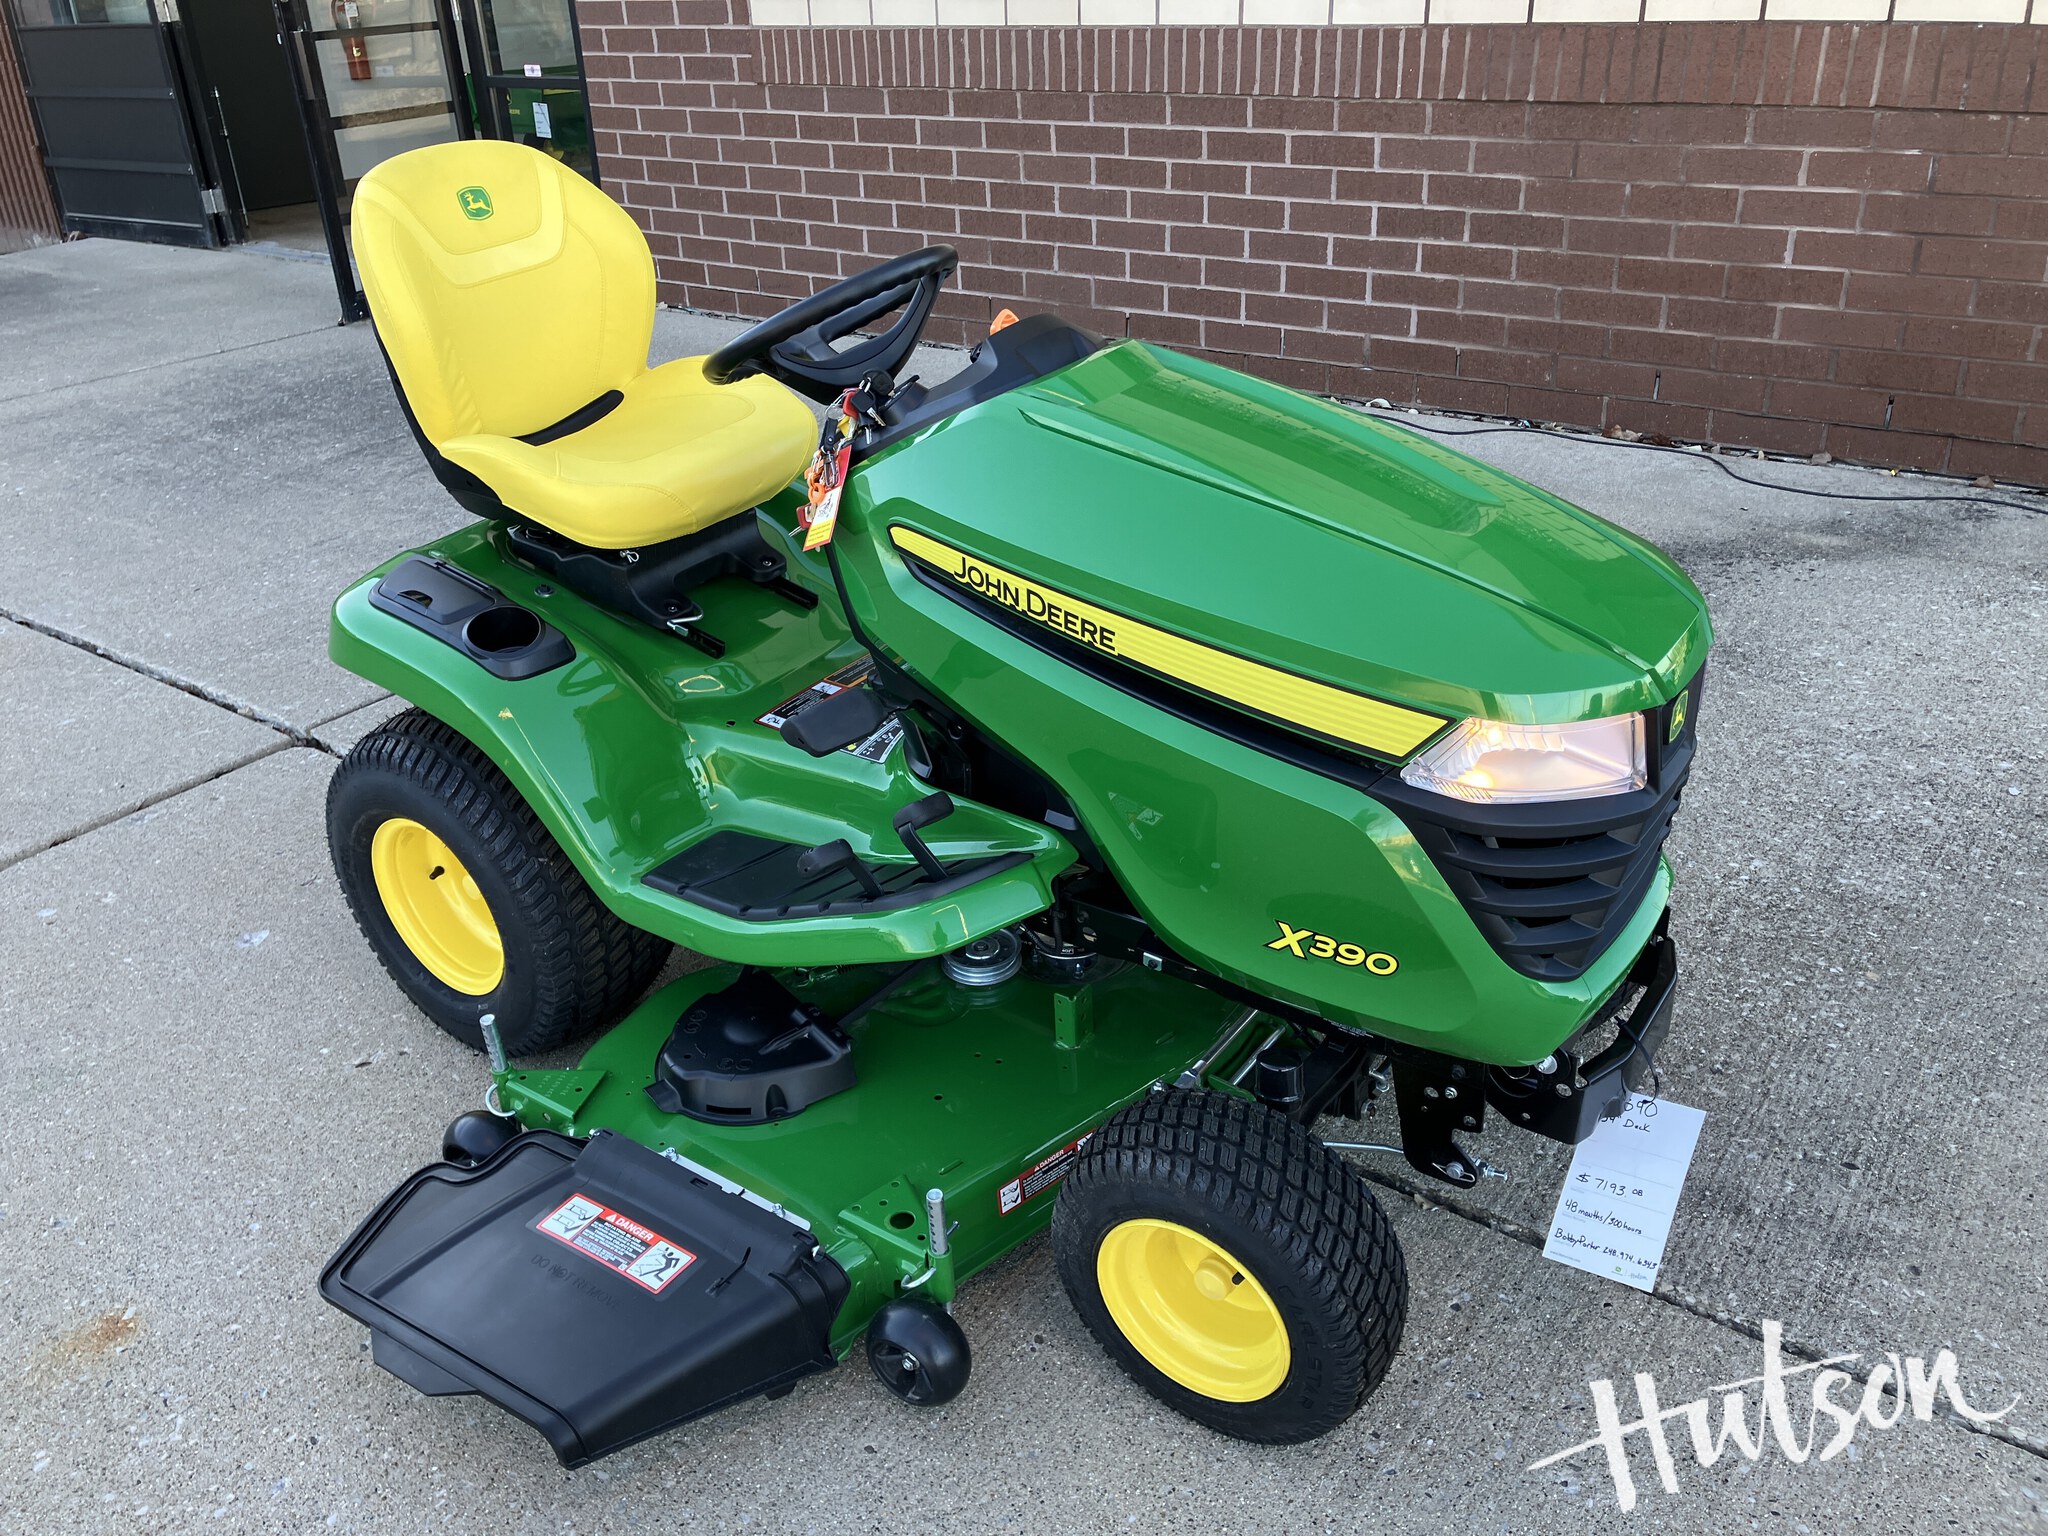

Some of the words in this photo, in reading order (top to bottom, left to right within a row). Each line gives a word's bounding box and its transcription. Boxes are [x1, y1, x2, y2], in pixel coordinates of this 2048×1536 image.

[954, 557, 1019, 607] JOHN
[1026, 588, 1116, 652] DEERE
[1264, 920, 1399, 976] X390
[1623, 1119, 1651, 1133] Deck
[1040, 1150, 1064, 1168] DANGER
[615, 1218, 654, 1242] DANGER
